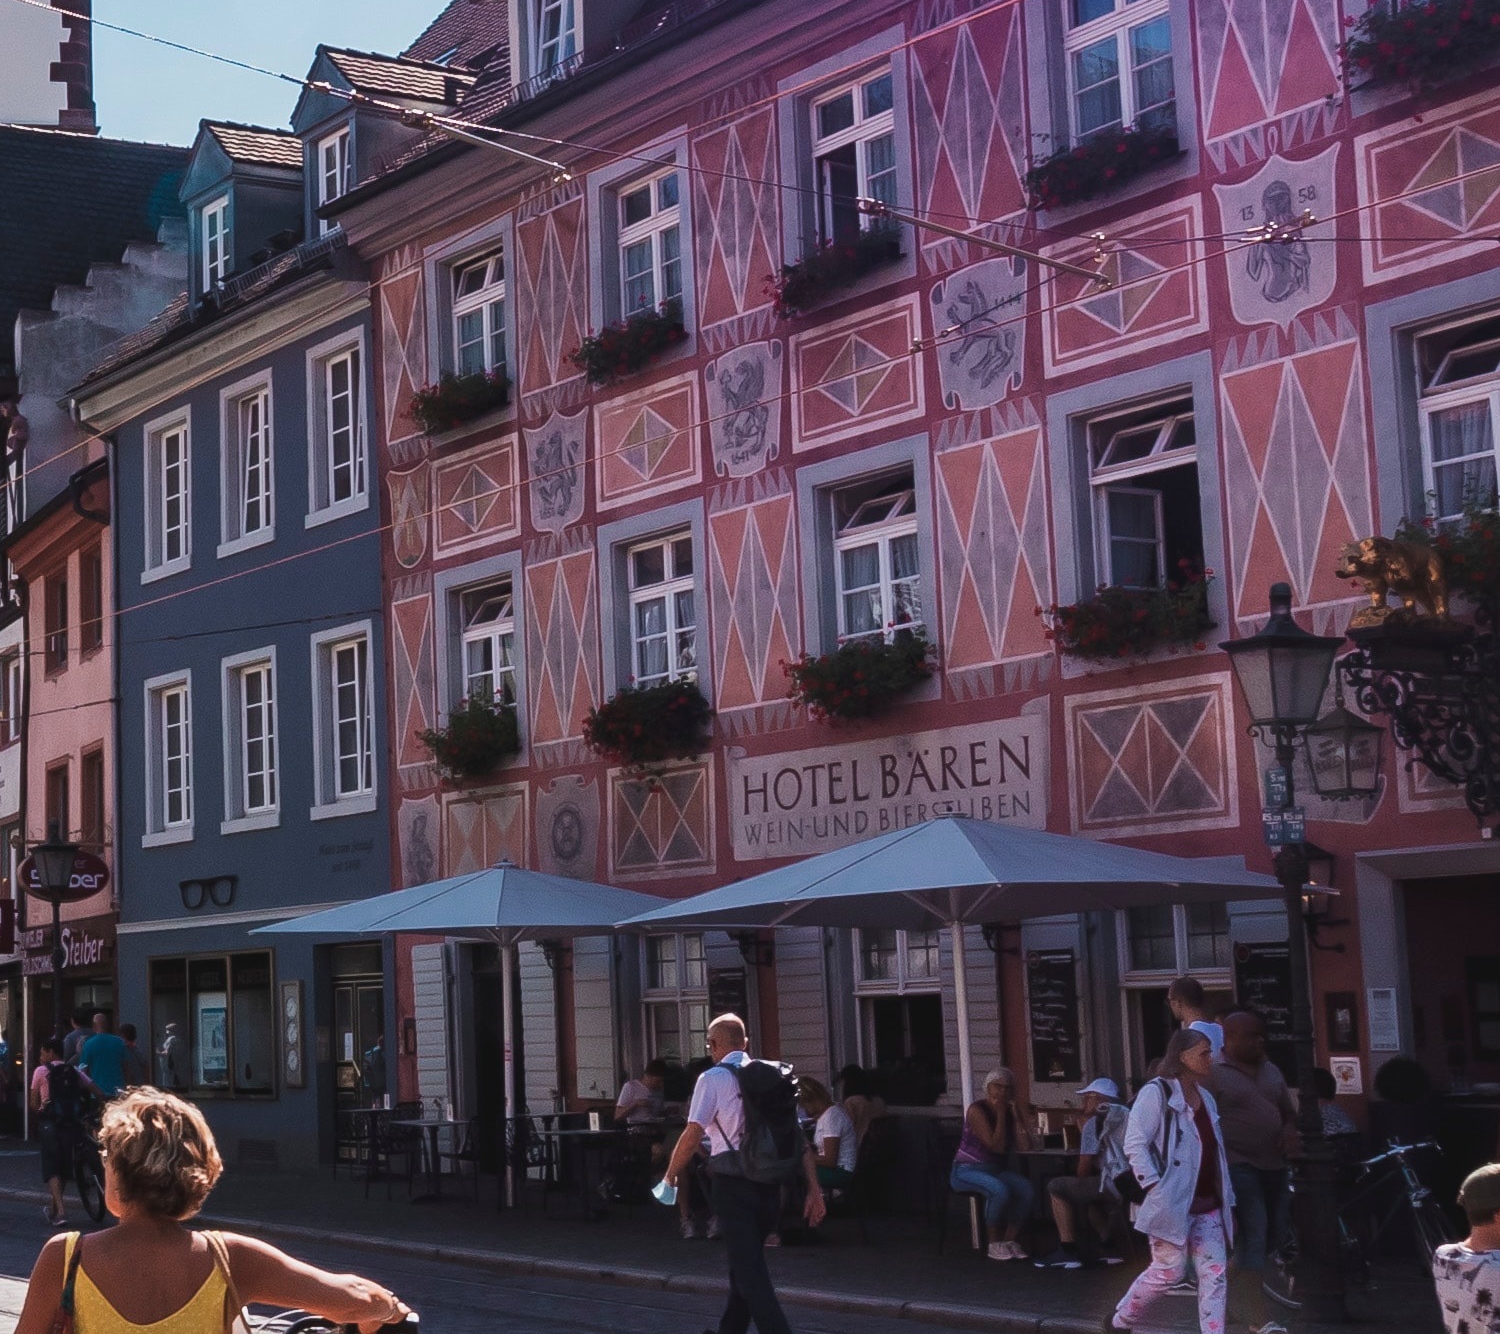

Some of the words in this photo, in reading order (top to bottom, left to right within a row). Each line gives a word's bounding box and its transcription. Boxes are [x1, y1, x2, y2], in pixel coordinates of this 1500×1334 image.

[743, 759, 869, 816] HOTEL
[879, 735, 1031, 799] BÄREN
[61, 927, 104, 969] Steiber
